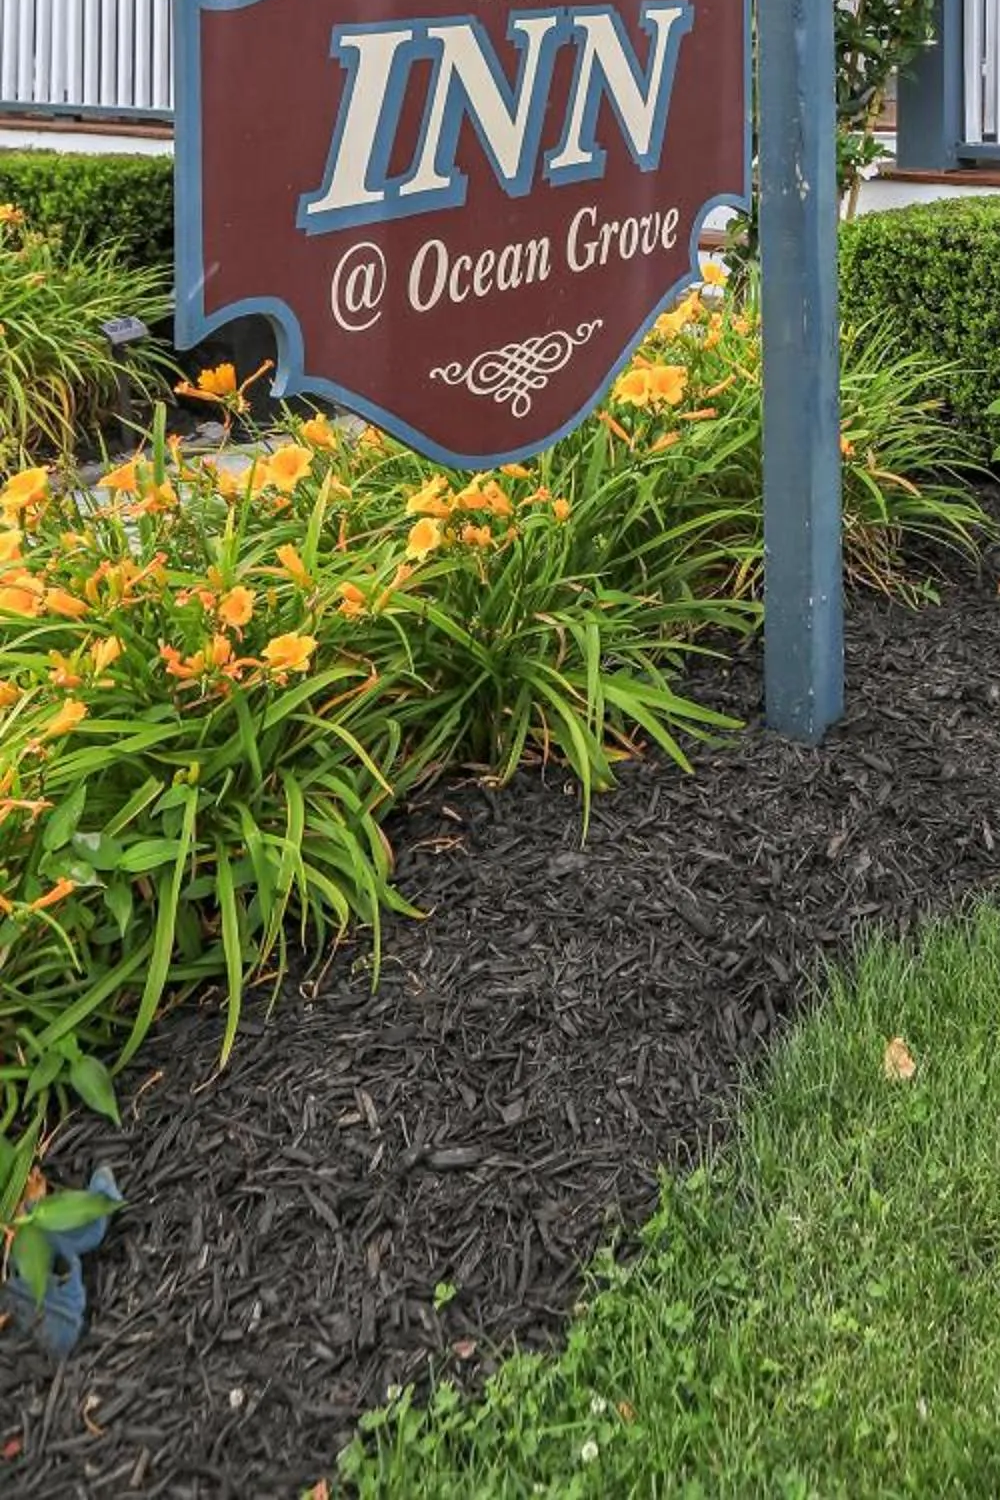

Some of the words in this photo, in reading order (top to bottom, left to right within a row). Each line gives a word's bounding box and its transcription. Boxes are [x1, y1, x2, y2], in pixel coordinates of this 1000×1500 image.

[305, 6, 684, 216] INN
[331, 241, 387, 332] @
[408, 237, 551, 313] Ocean
[566, 205, 680, 273] Grove
